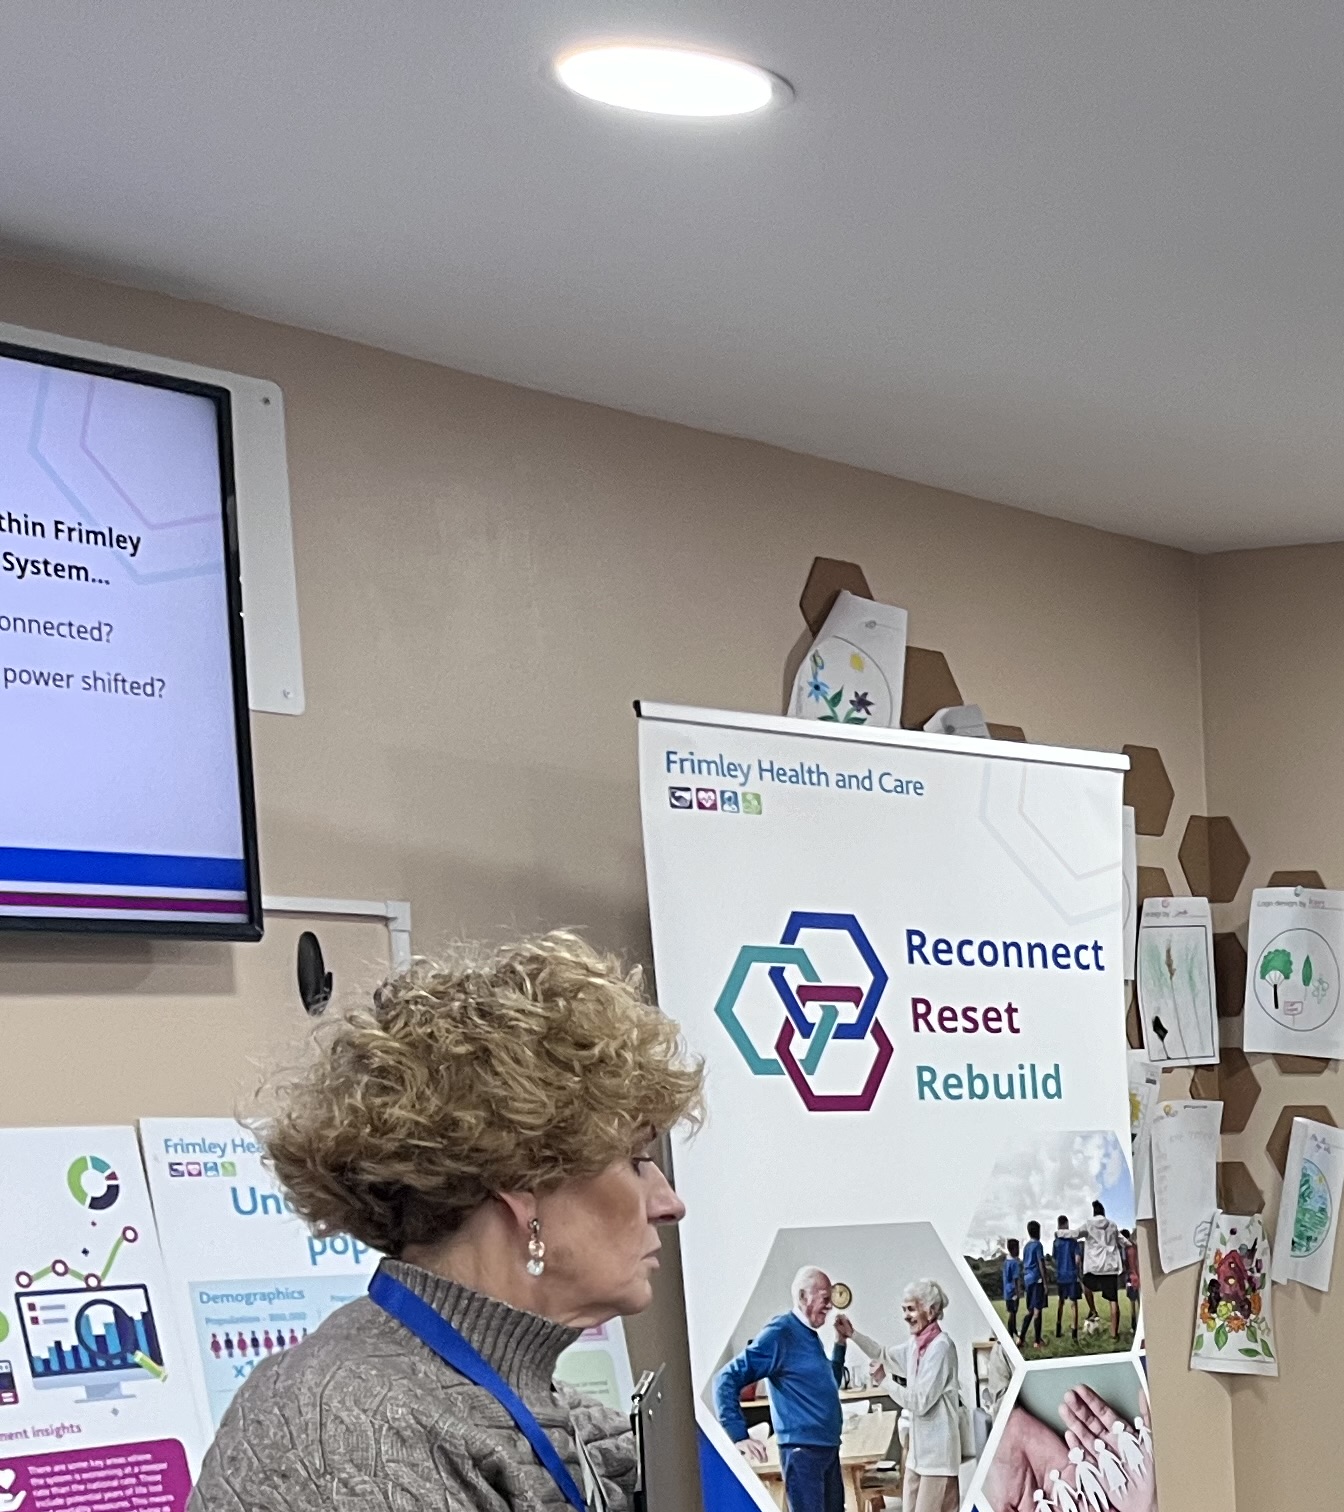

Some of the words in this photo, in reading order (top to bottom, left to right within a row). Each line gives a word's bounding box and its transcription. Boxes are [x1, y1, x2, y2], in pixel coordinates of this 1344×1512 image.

[0, 510, 46, 539] thin
[54, 519, 142, 557] Frimley
[2, 551, 110, 585] System...
[0, 615, 113, 643] onnected?
[3, 667, 74, 689] power
[81, 670, 166, 699] shifted?
[666, 750, 751, 786] Frimley
[758, 759, 829, 787] Health
[835, 769, 873, 792] and
[878, 772, 924, 796] Care
[906, 928, 1106, 971] Reconnect
[910, 997, 1021, 1034] Reset
[915, 1063, 1063, 1101] Rebuild
[164, 1137, 227, 1158] Frimley
[307, 1233, 369, 1266] pop
[199, 1287, 305, 1306] Demographics
